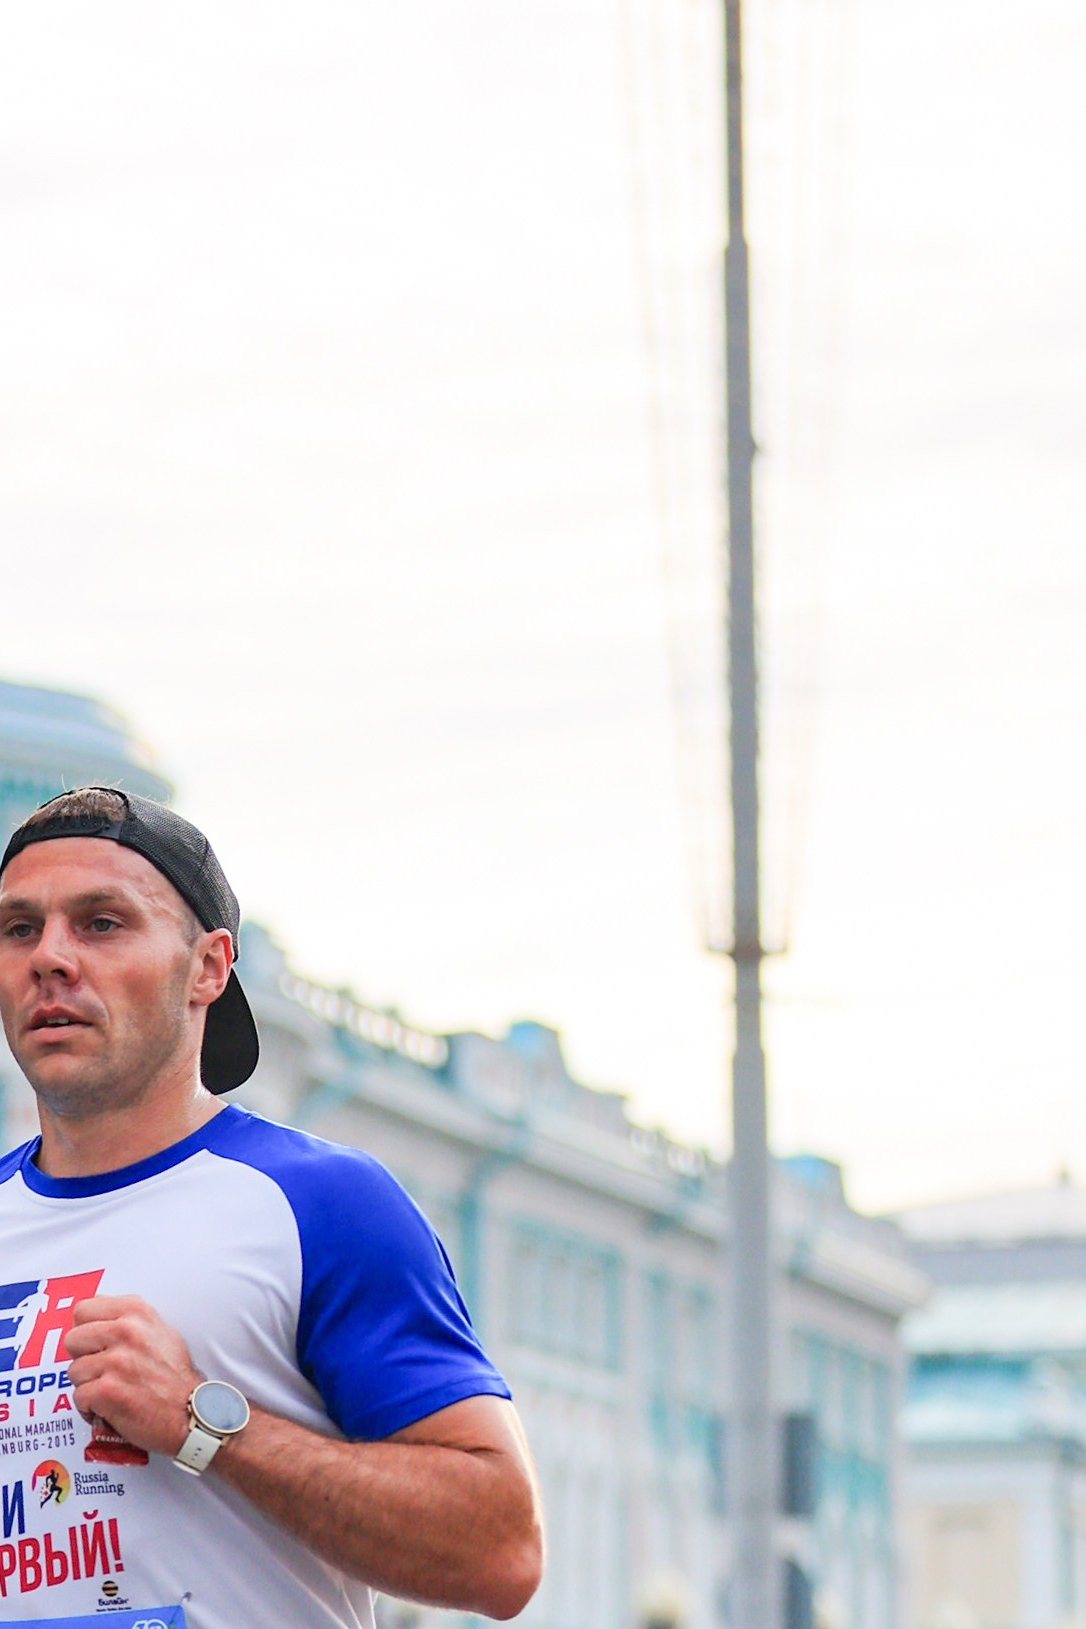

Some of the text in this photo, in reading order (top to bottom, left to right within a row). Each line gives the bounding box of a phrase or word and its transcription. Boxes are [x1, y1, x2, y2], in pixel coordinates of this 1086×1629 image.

[25, 1417, 74, 1437] MARATHON
[73, 1470, 110, 1484] Russia
[75, 1482, 126, 1497] Running
